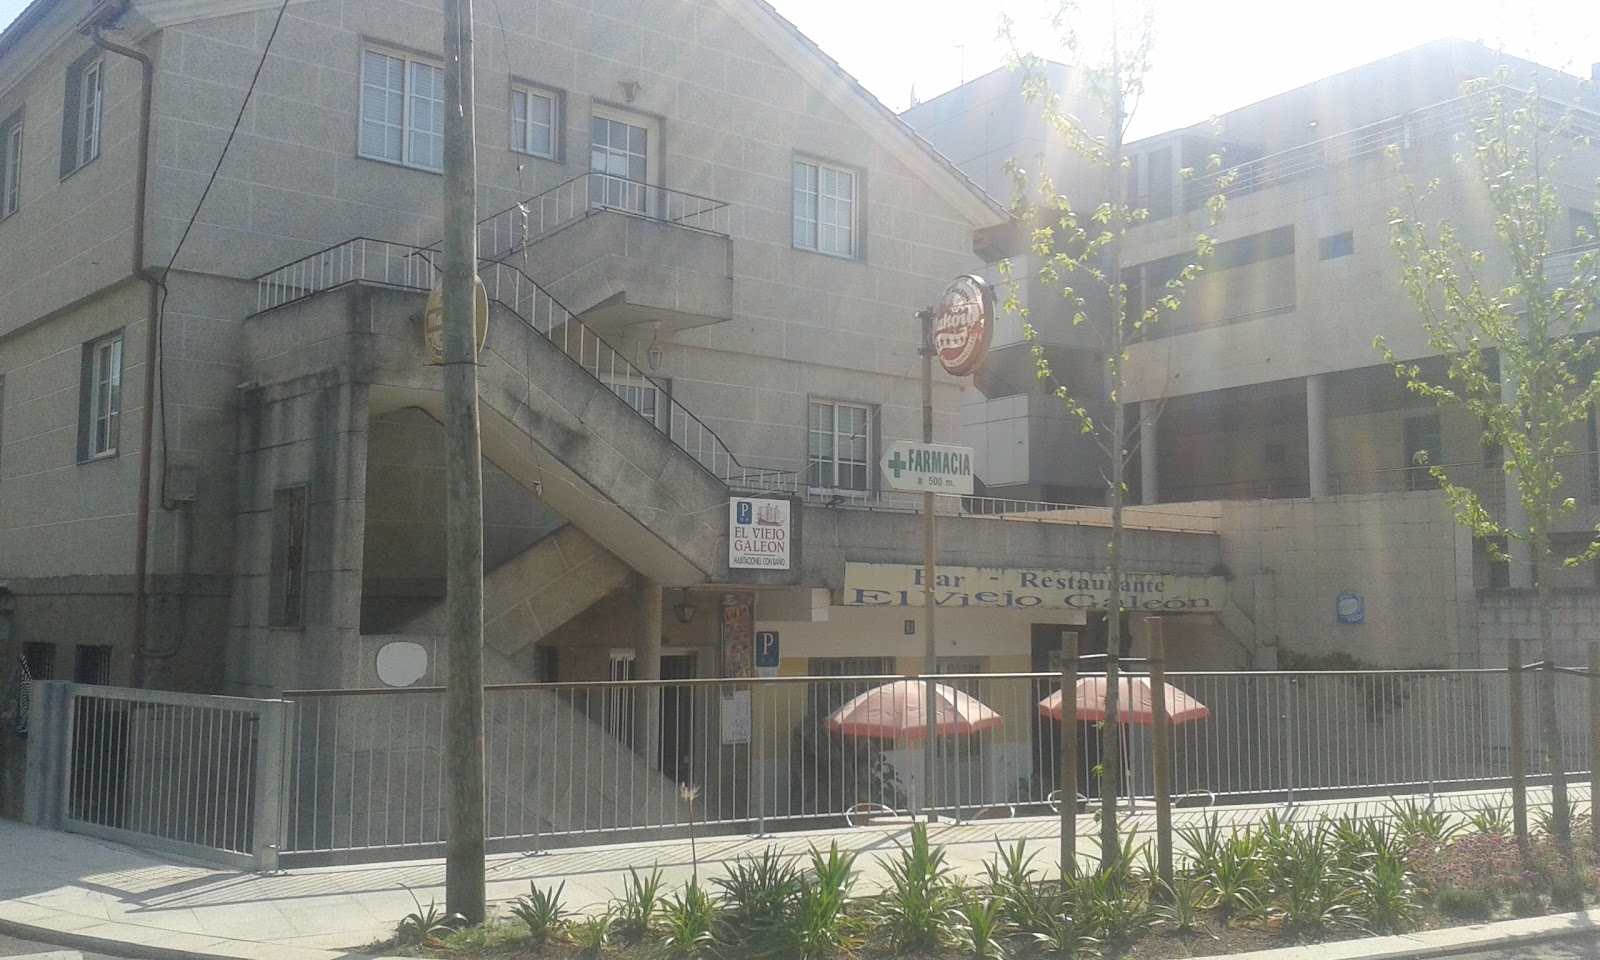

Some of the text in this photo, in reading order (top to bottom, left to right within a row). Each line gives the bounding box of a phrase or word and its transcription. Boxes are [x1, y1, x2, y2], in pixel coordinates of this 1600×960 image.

[908, 449, 971, 476] FARMACIA
[917, 477, 923, 485] a
[928, 476, 943, 486] 500
[741, 503, 749, 517] P
[734, 526, 785, 541] EL VIEJO
[734, 539, 785, 553] GALEON
[913, 568, 966, 588] Bar
[852, 588, 909, 607] El
[919, 590, 1043, 607] Viejo
[762, 633, 774, 655] P
